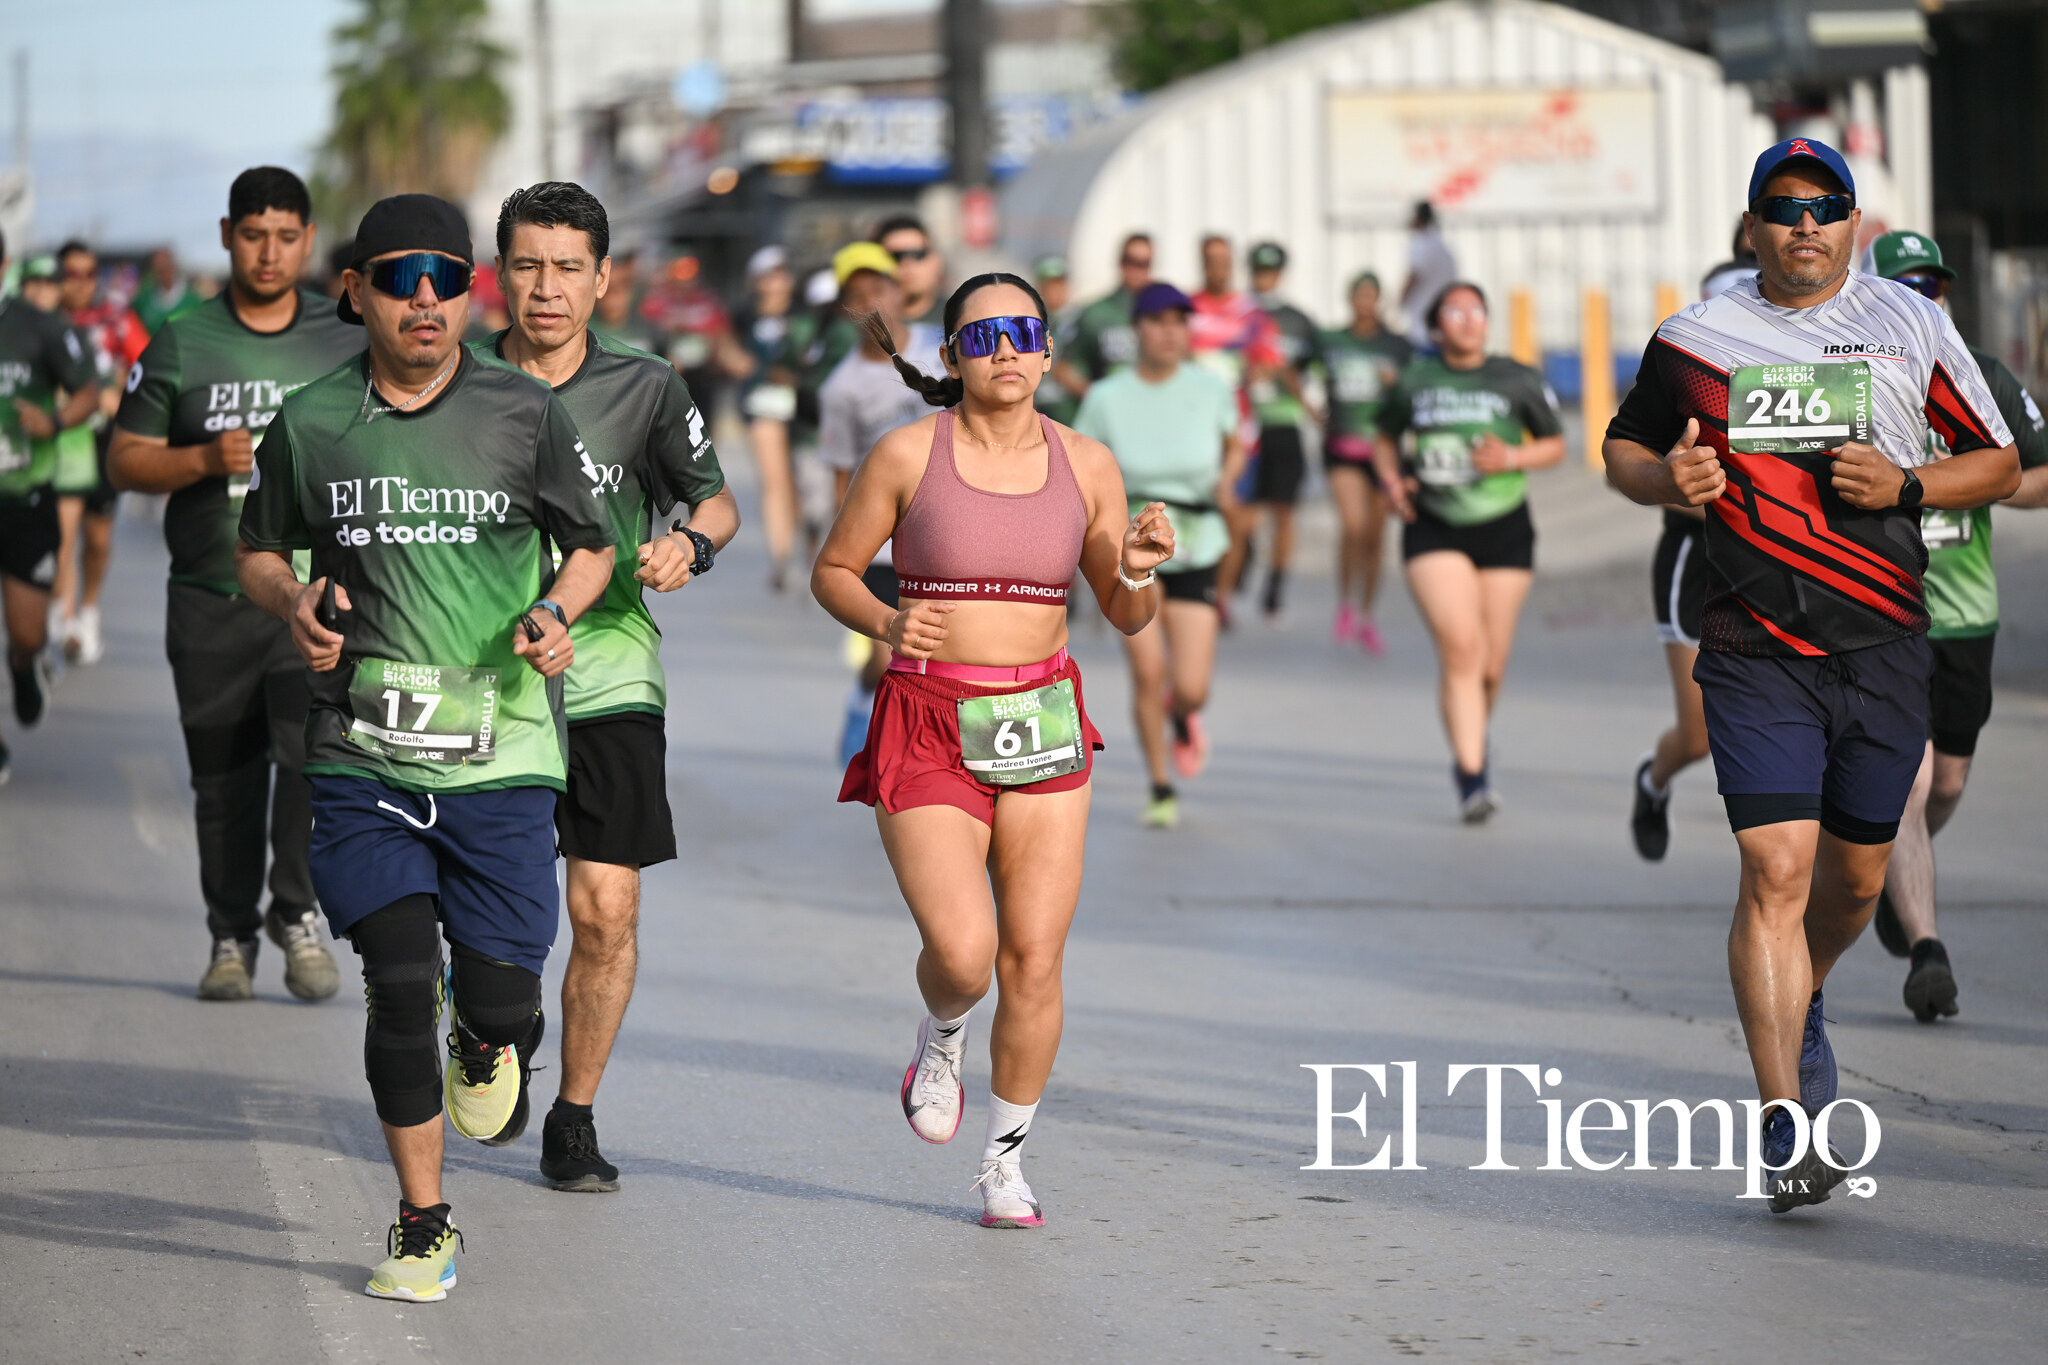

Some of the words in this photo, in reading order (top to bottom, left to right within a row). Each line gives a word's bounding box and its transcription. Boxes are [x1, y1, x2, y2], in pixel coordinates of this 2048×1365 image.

[1823, 343, 1907, 358] IRONCAST
[1762, 366, 1815, 374] CARRERA
[1852, 368, 1869, 376] 246
[208, 381, 240, 412] El
[1745, 388, 1832, 425] 246
[1855, 381, 1868, 440] MEDALLA
[204, 412, 243, 432] de
[326, 478, 365, 518] El
[369, 476, 511, 524] Tiempo
[335, 524, 372, 547] de
[375, 520, 478, 545] todos
[922, 583, 978, 593] UNDER
[1007, 584, 1064, 598] ARMOUR
[383, 662, 441, 676] CARRERA
[485, 675, 497, 683] 17
[991, 692, 1039, 705] CARRERA
[381, 689, 443, 732] 17
[477, 690, 496, 753] MEDALLA
[388, 733, 425, 744] Rodolfo
[993, 716, 1042, 757] 61
[991, 759, 1025, 769] Andrea
[1026, 754, 1052, 765] Ivonee
